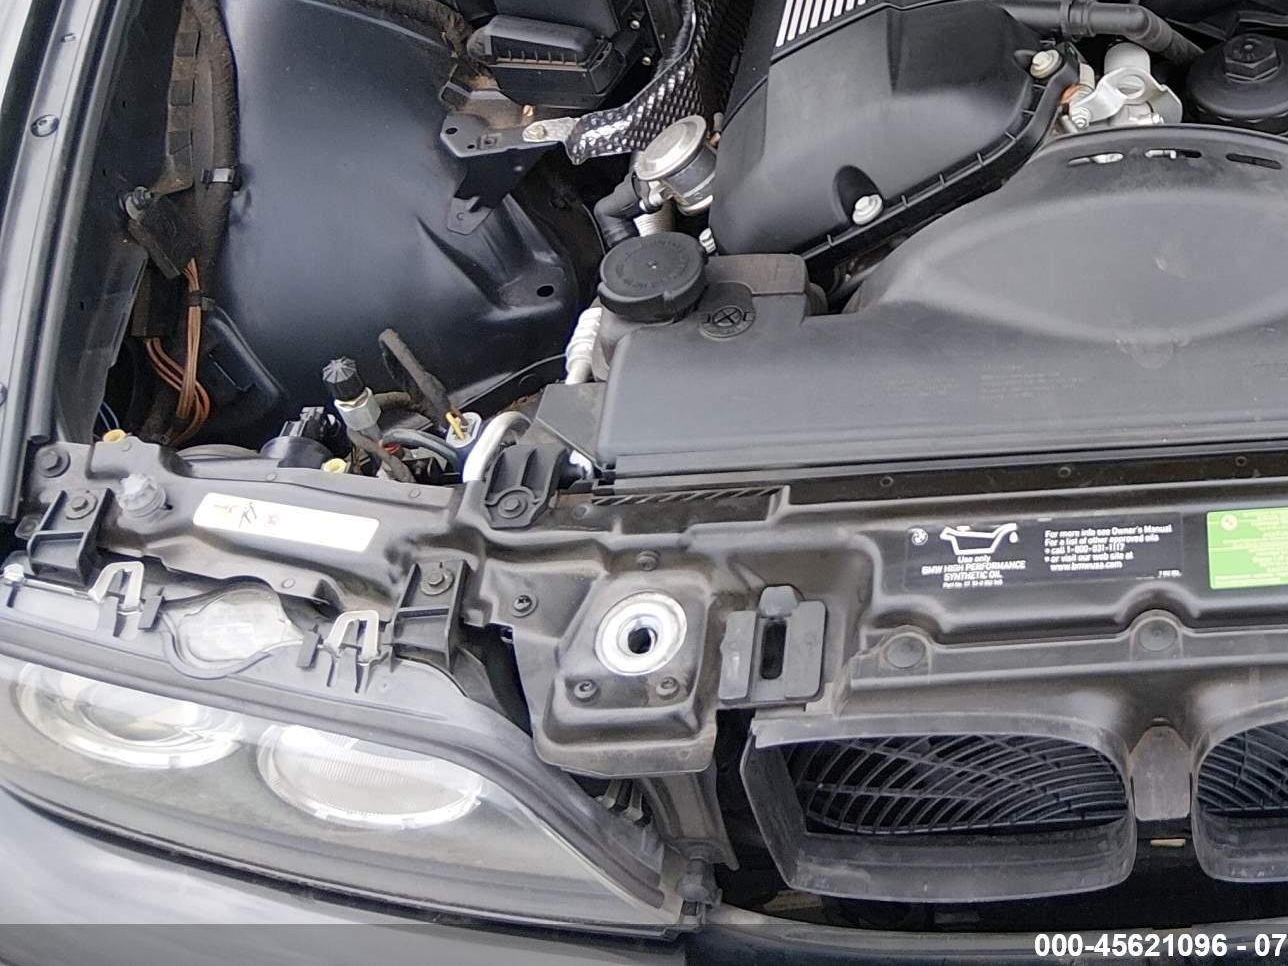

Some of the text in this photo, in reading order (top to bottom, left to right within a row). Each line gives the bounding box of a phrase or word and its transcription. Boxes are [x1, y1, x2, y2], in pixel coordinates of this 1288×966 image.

[1044, 529, 1058, 538] For
[1059, 530, 1080, 538] more
[1112, 526, 1143, 535] Owner's
[1144, 524, 1173, 534] Manual
[1044, 538, 1058, 547] For
[1065, 537, 1078, 546] list
[1087, 536, 1108, 545] other
[1050, 545, 1065, 554] call
[957, 555, 991, 564] Use only
[1092, 552, 1109, 561] web
[1109, 551, 1124, 560] site
[943, 563, 964, 573] HIGH
[965, 560, 1026, 571] PERFORMANCE
[943, 570, 1003, 582] SYNTHETIC OIL
